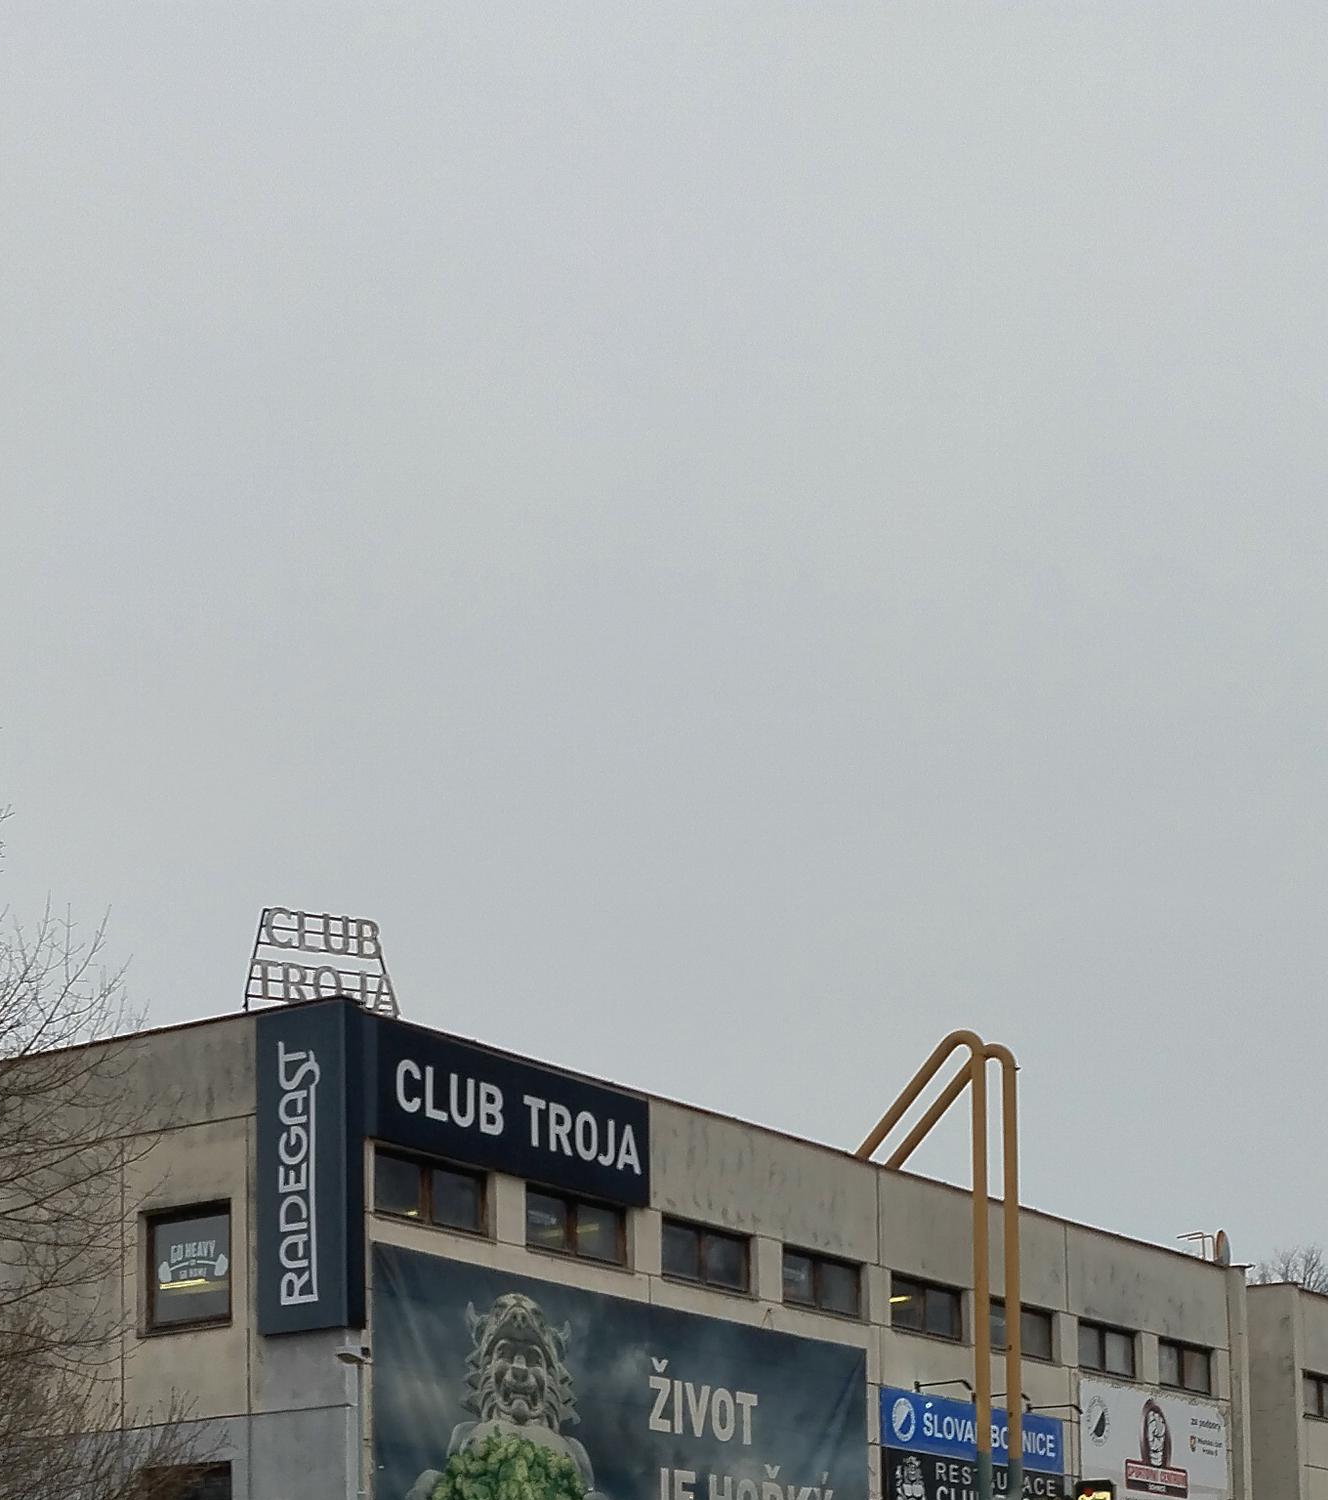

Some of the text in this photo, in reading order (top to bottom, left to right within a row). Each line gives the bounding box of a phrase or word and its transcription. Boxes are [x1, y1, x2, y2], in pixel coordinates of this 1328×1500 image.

[266, 907, 382, 959] CLUB
[251, 958, 400, 1019] TROJA
[396, 1059, 642, 1175] CLUB TROJA
[278, 1041, 320, 1306] RADEGAST
[648, 1357, 759, 1445] ŽIVOT
[923, 1412, 978, 1443] SLOVA
[991, 1424, 1056, 1458] BONICE
